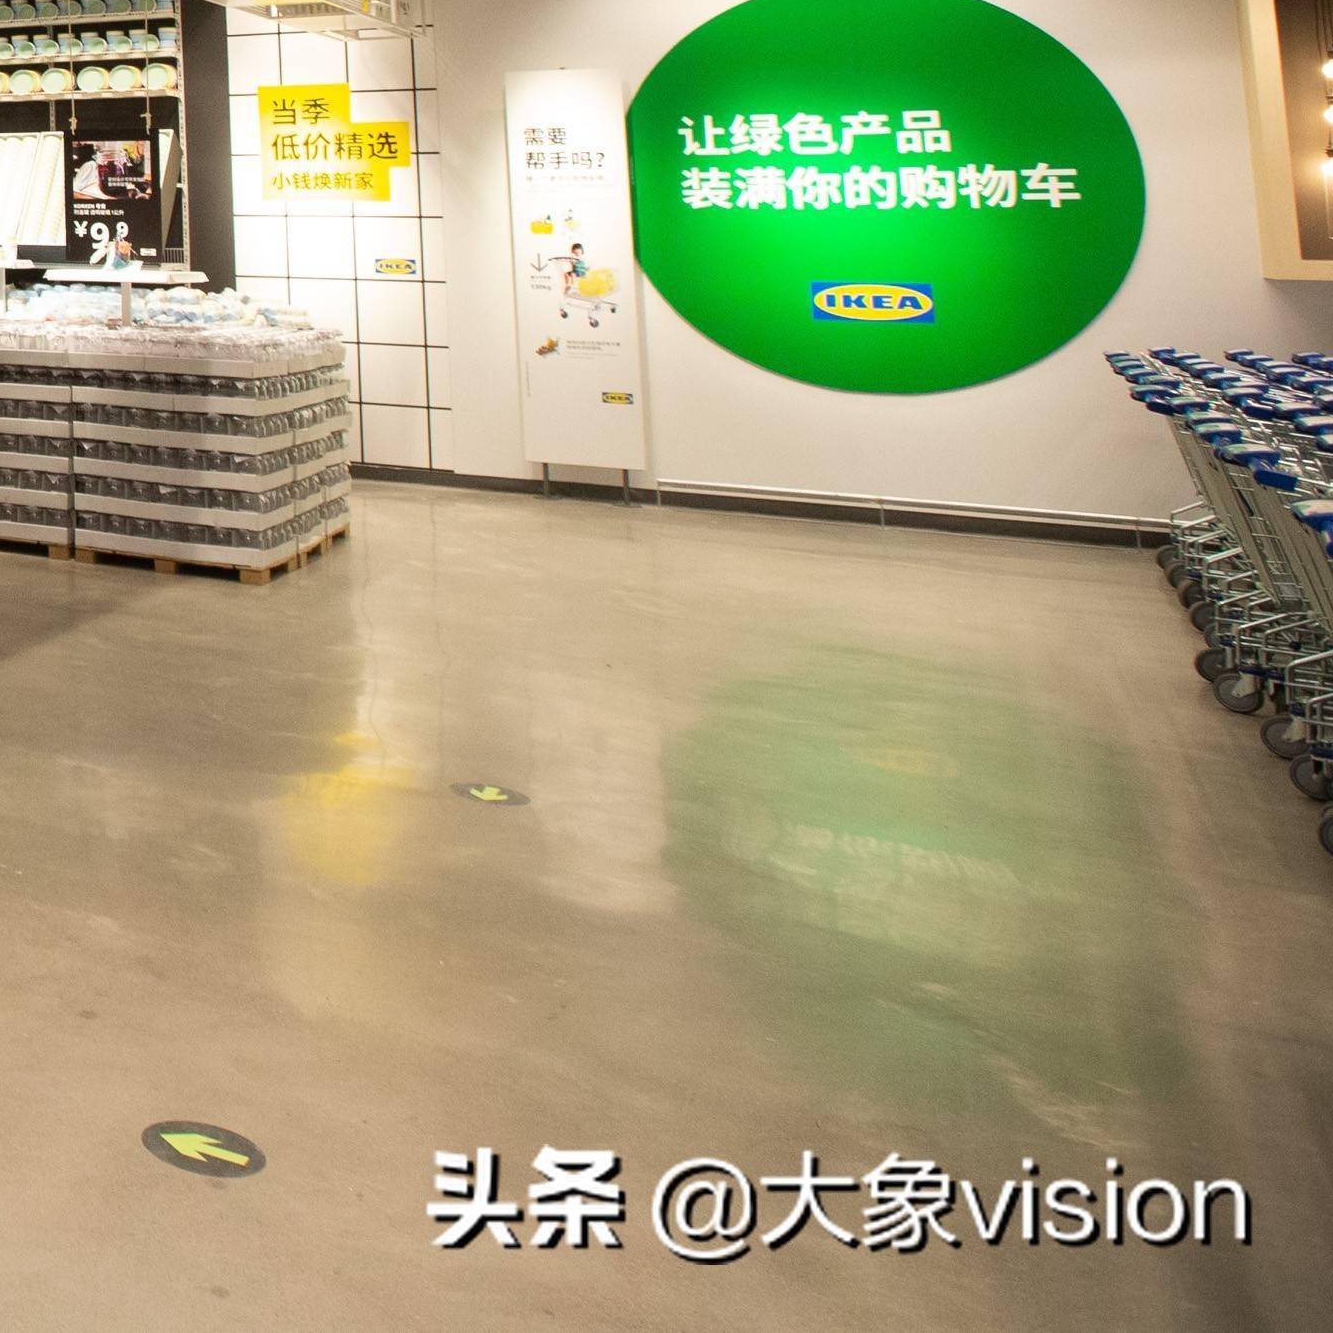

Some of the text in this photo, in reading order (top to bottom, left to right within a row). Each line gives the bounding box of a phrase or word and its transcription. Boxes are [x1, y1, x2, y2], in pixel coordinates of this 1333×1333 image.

[272, 97, 331, 125] 当季
[524, 128, 568, 146] 需要
[678, 110, 952, 156] 让绿色产品
[271, 131, 399, 161] 低价精选
[273, 171, 374, 191] 小钱焕新家
[680, 162, 1082, 210] 装满你的购物车
[377, 261, 415, 273] IKEA
[823, 291, 926, 312] IKEA
